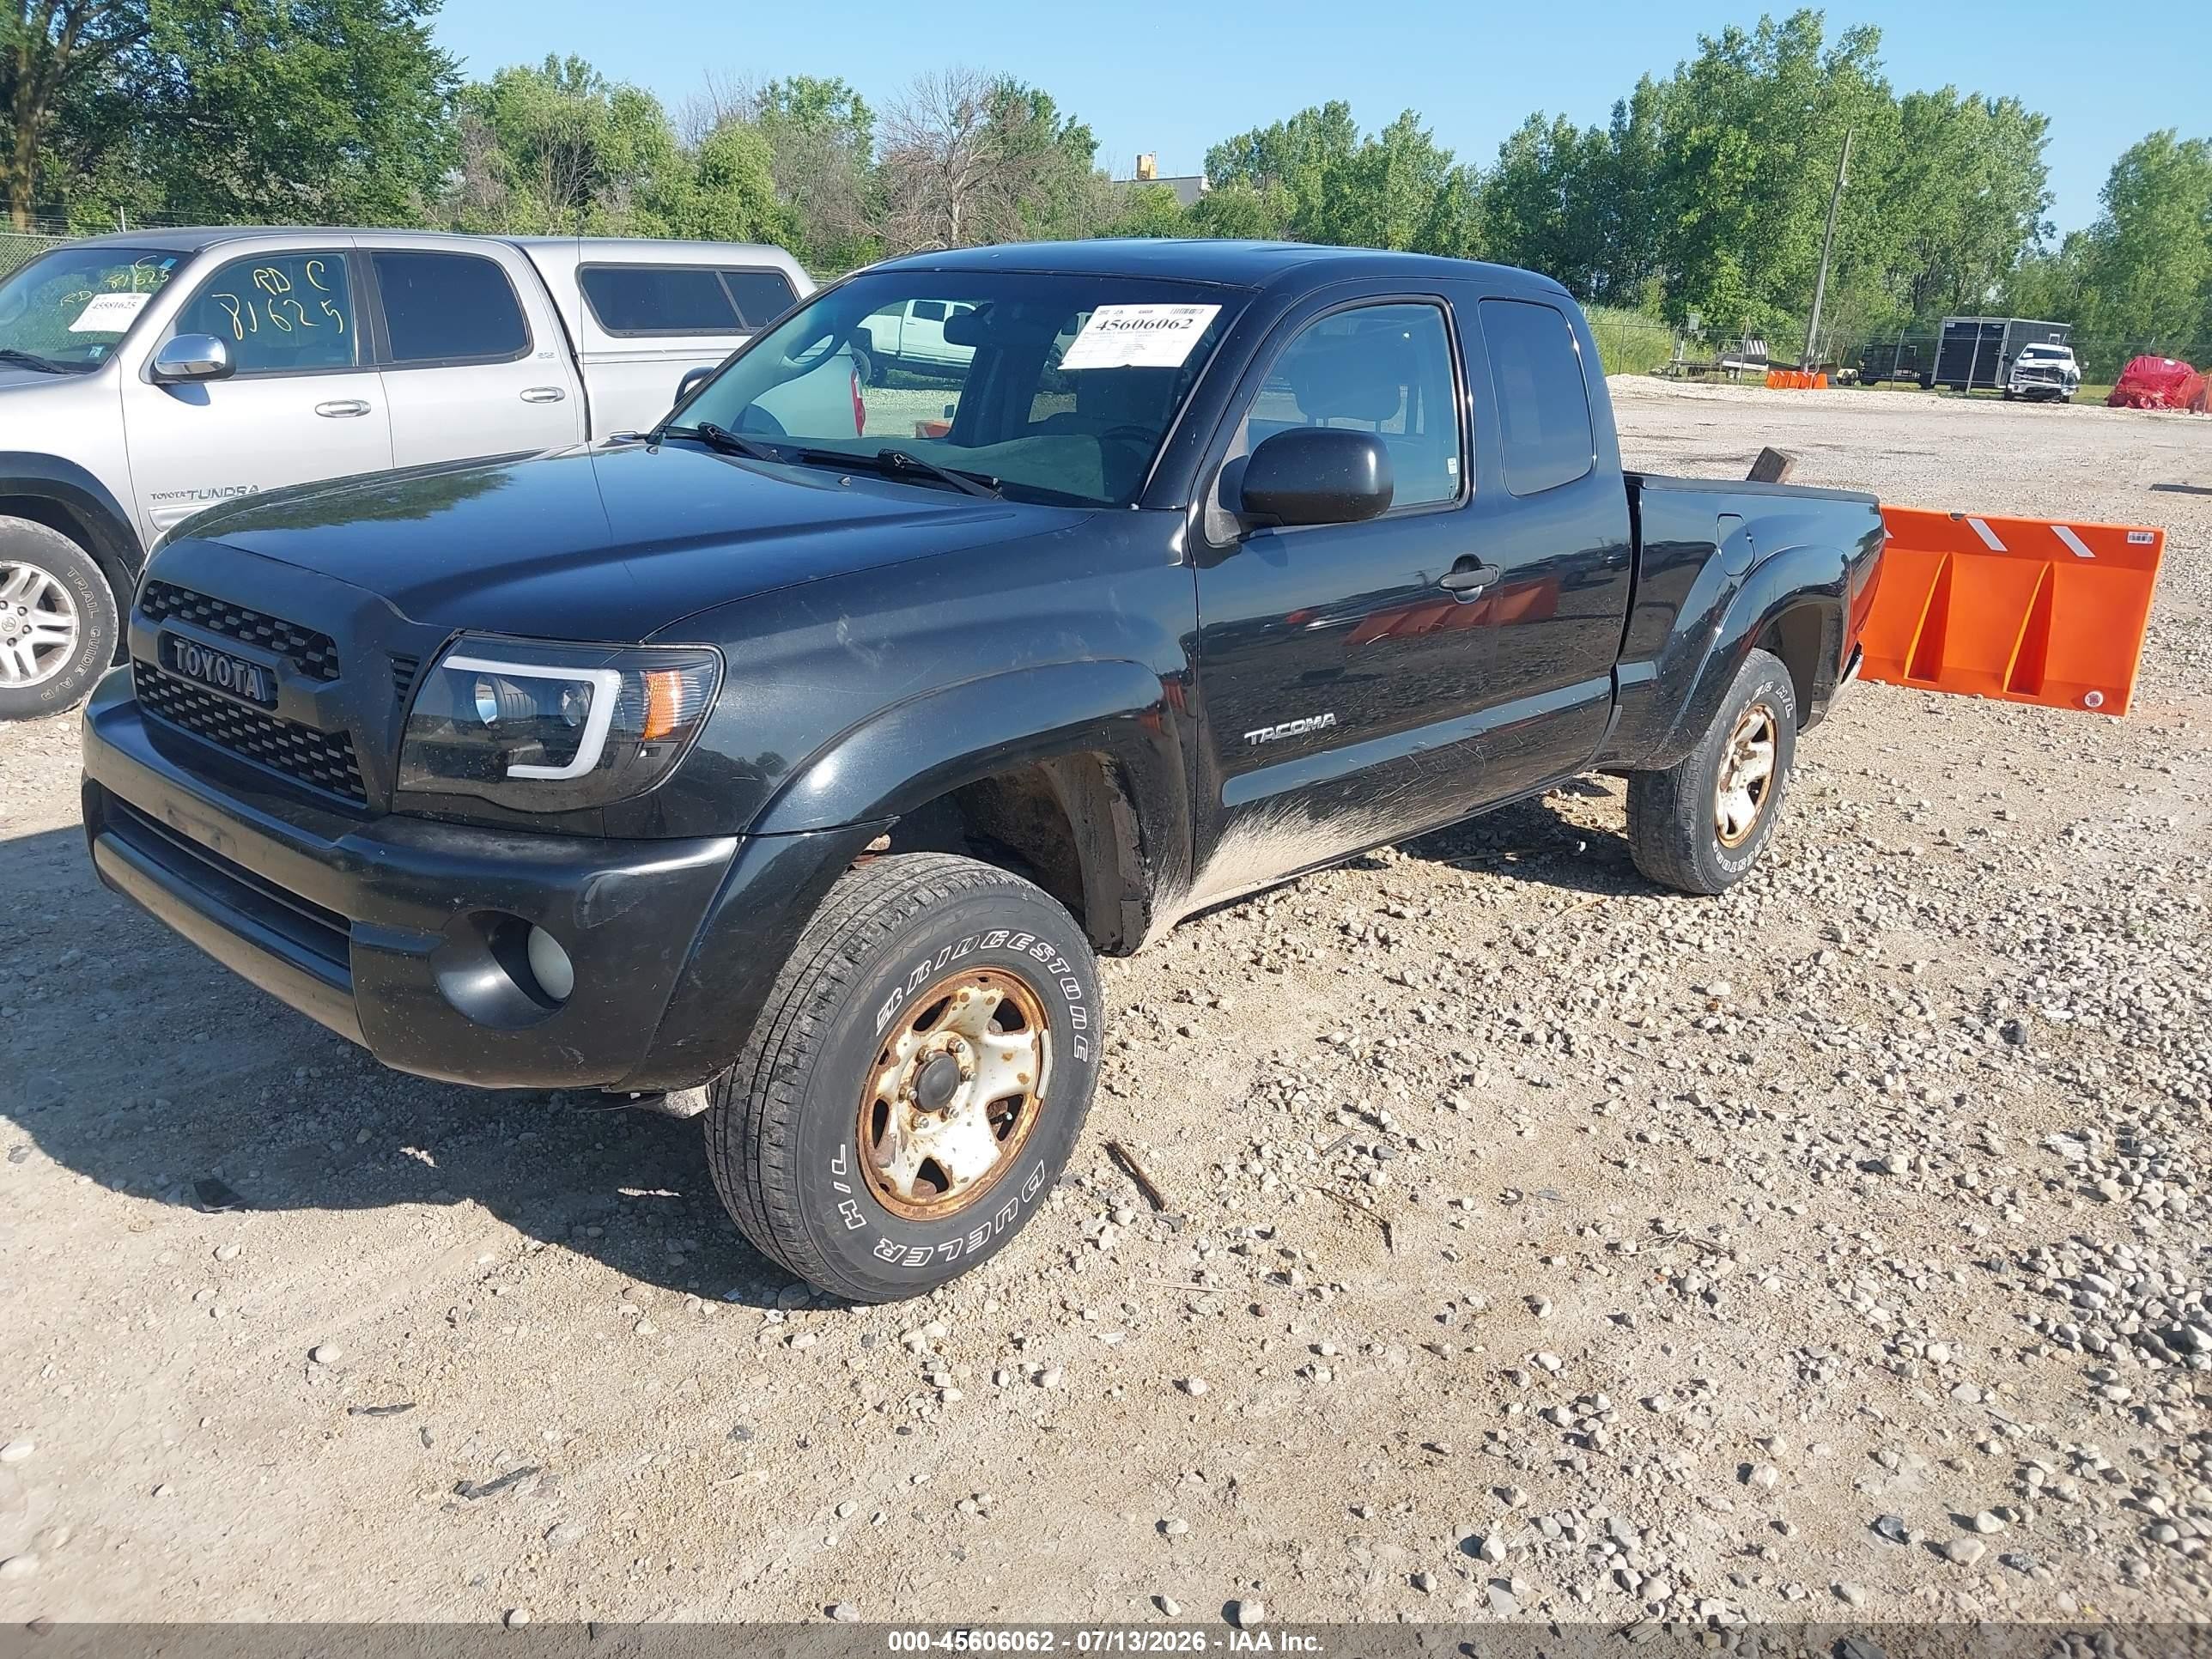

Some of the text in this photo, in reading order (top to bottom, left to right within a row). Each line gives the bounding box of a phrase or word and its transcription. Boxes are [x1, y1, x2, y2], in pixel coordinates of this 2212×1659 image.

[252, 267, 291, 295] RD
[211, 294, 343, 341] 81625
[1096, 318, 1194, 331] 45606062
[185, 484, 260, 501] TUNDRA
[66, 565, 100, 619] TRAIL
[74, 625, 101, 677] GUIDE
[173, 639, 266, 702] TOYOTA
[1243, 713, 1337, 746] TACOMA
[876, 930, 1088, 1063] BRIDGESTONE
[872, 1159, 1045, 1267] DUELER
